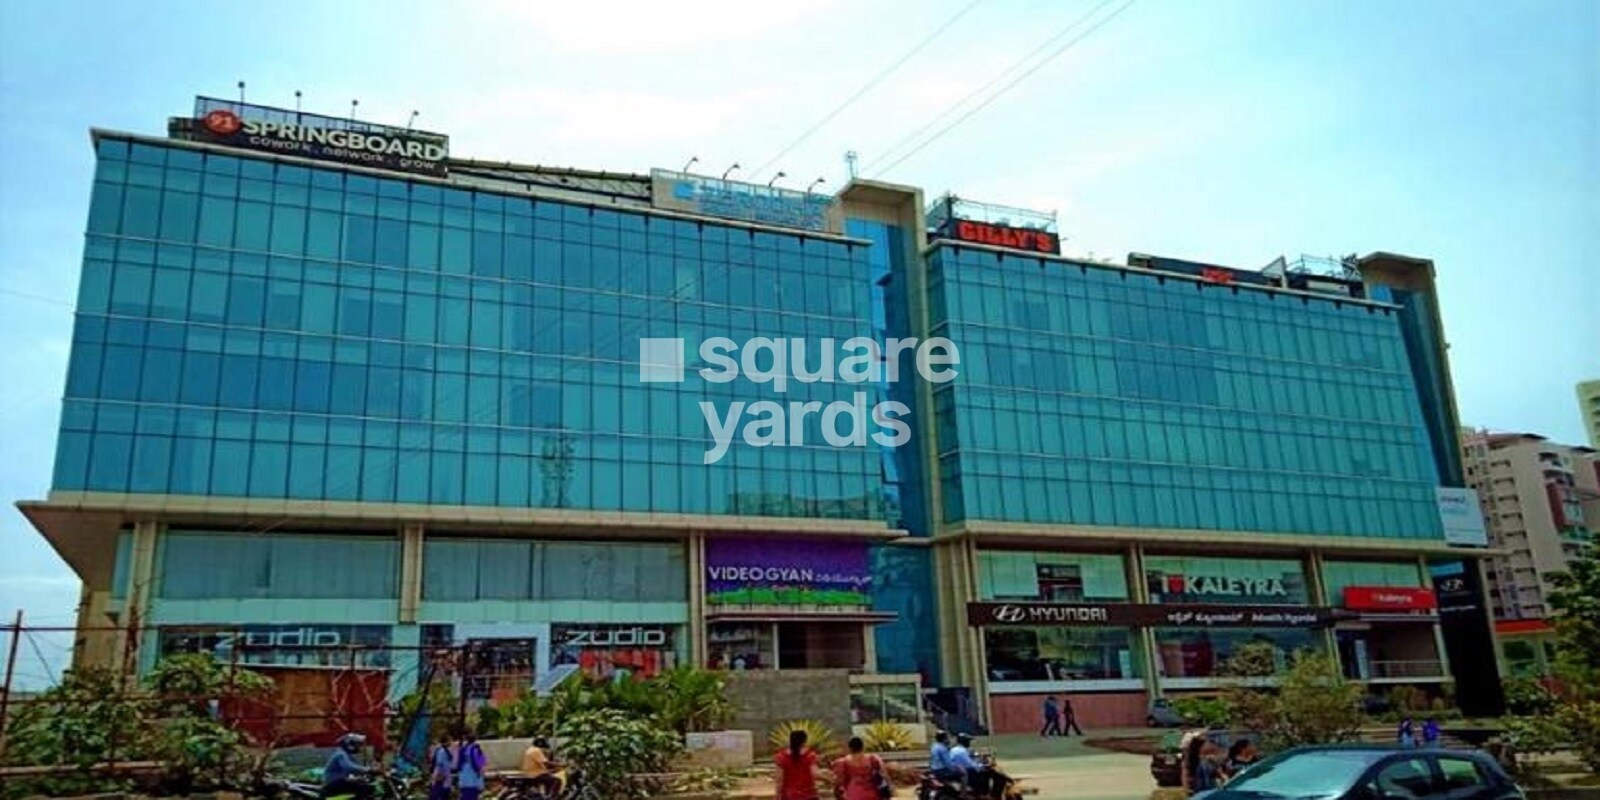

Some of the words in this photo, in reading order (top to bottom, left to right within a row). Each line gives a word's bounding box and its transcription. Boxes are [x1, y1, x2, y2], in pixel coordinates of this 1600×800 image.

[242, 120, 445, 161] SPRINGBOARD
[958, 221, 1054, 252] GILLY'S
[708, 566, 813, 581] VIDEOGYAN
[1184, 576, 1287, 596] KALEYRA
[1029, 607, 1109, 621] HYUNDAI
[215, 627, 340, 649] zudio
[566, 627, 666, 645] zudio
